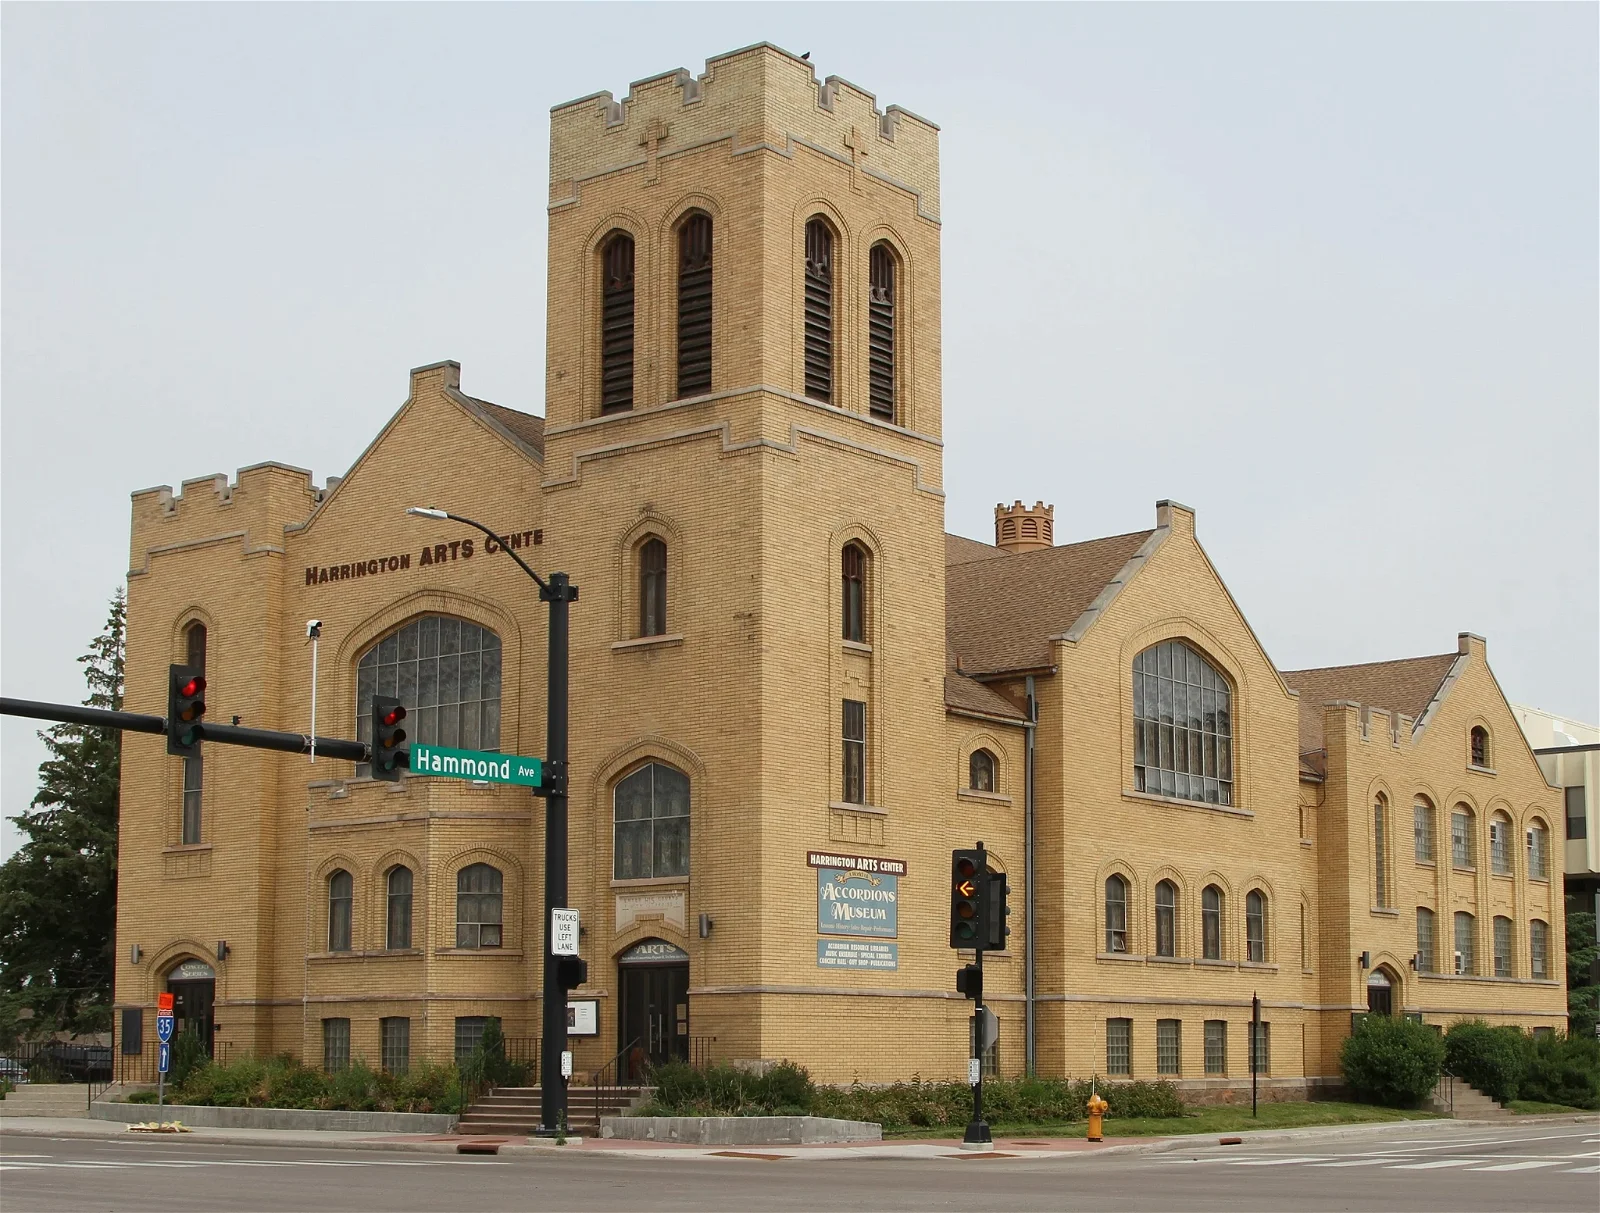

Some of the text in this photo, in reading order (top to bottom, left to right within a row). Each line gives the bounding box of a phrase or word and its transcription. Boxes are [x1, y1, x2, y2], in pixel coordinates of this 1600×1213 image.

[305, 553, 410, 585] HARRINGTON
[419, 538, 474, 566] ARTS
[417, 748, 535, 779] Hammond Ave
[810, 854, 904, 873] HARRINGTON ARTS CENTER
[820, 882, 896, 903] ACCORDIONS
[554, 913, 577, 922] TRUCKS
[831, 901, 887, 920] MUSEUM
[558, 933, 572, 941] LEFT
[634, 944, 677, 955] ARTS
[159, 1018, 171, 1034] 35
